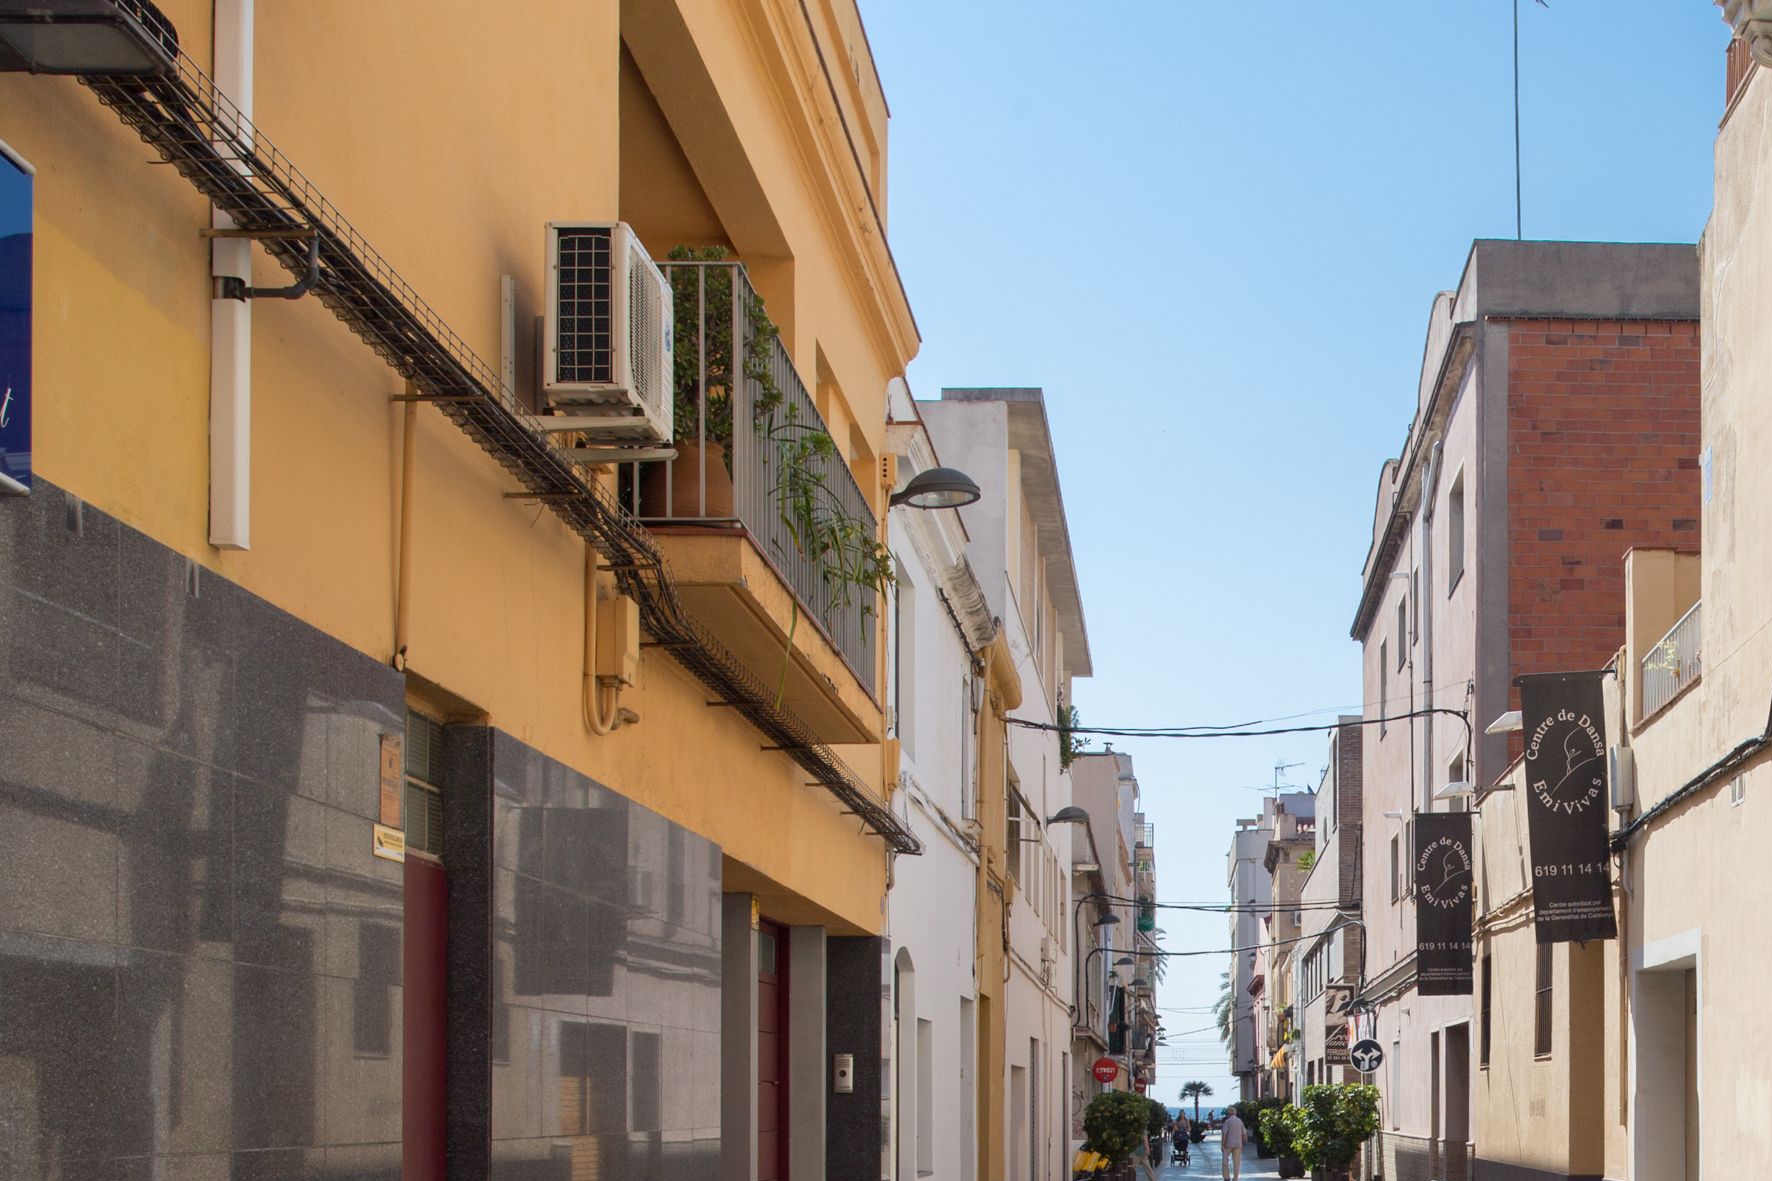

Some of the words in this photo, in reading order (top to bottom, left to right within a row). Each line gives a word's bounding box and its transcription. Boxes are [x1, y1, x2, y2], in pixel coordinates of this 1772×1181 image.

[1526, 716, 1555, 760] Centre
[1557, 708, 1575, 722] de
[1578, 714, 1605, 757] Dansa
[1533, 779, 1561, 812] Emi
[1563, 777, 1602, 815] Vivas
[1417, 841, 1438, 871] Centre
[1440, 836, 1452, 846] de
[1453, 841, 1471, 871] Dansa
[1535, 865, 1558, 877] 619
[1561, 864, 1573, 876] 11
[1578, 863, 1592, 875] 14
[1596, 862, 1610, 873] 14
[1421, 884, 1440, 907] Emi
[1441, 884, 1468, 909] Vivas
[1419, 942, 1434, 951] 619
[1437, 941, 1446, 950] 11
[1449, 941, 1458, 950] 14
[1461, 941, 1470, 949] 14
